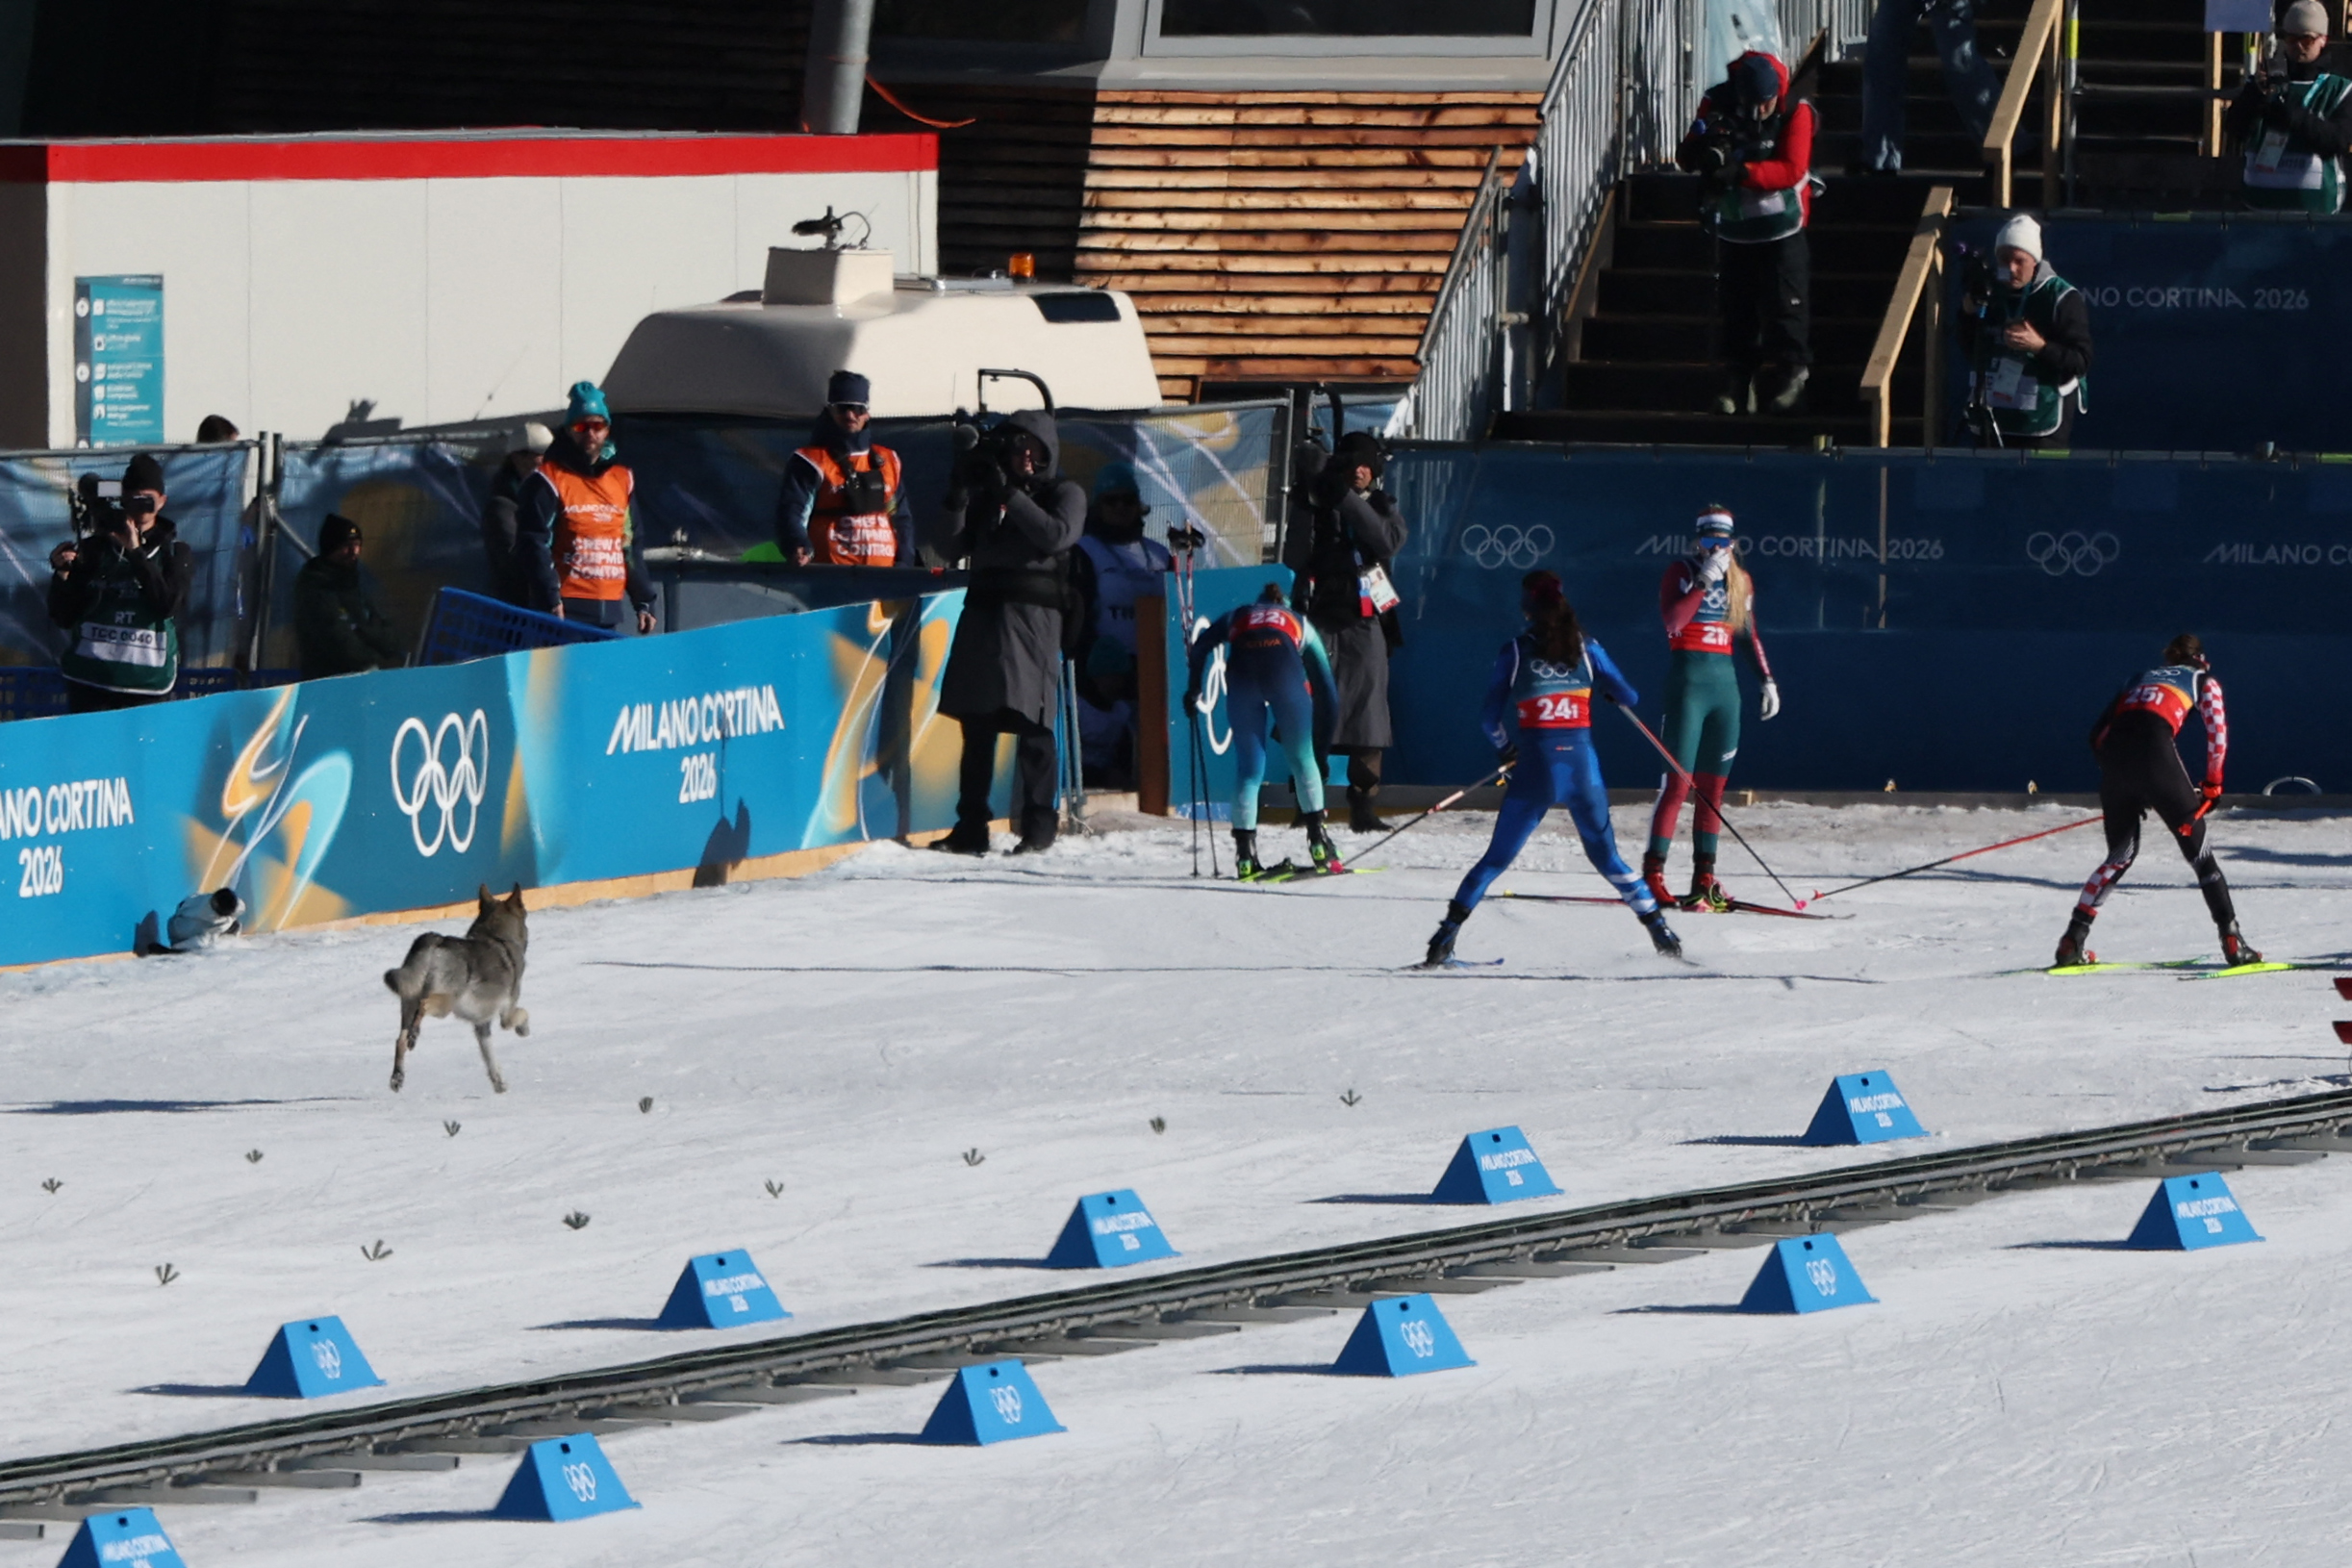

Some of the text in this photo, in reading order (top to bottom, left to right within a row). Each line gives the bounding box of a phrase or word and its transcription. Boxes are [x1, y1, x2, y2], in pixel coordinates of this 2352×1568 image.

[2126, 287, 2247, 310] CORTINA
[2254, 288, 2310, 310] 2026
[1758, 537, 1879, 559] CORTINA
[1886, 539, 1945, 560] 2026
[2202, 543, 2322, 566] MILANO
[114, 611, 137, 625] RT
[120, 632, 153, 645] 0040
[605, 684, 786, 756] MILANO CORTINA
[678, 751, 718, 805] 2026
[45, 776, 135, 835] CORTINA
[18, 844, 64, 898] 2026
